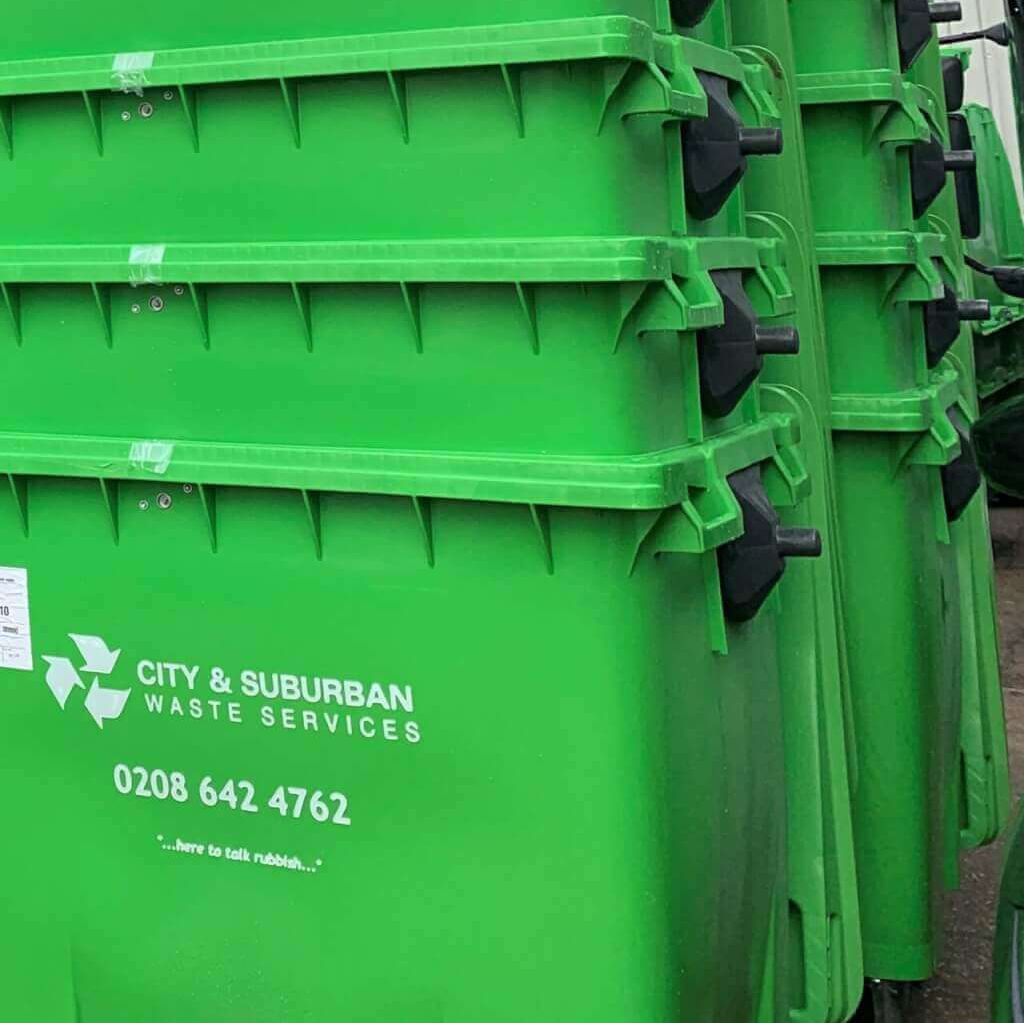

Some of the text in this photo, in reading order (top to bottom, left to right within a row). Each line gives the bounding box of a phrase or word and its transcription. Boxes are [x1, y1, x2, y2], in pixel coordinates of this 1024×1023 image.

[137, 659, 414, 713] CITY & SUBURBAN
[144, 692, 421, 744] WASTE SERVICES
[113, 763, 352, 826] 0208 642 4762
[207, 844, 223, 858] to
[224, 847, 251, 863] talk
